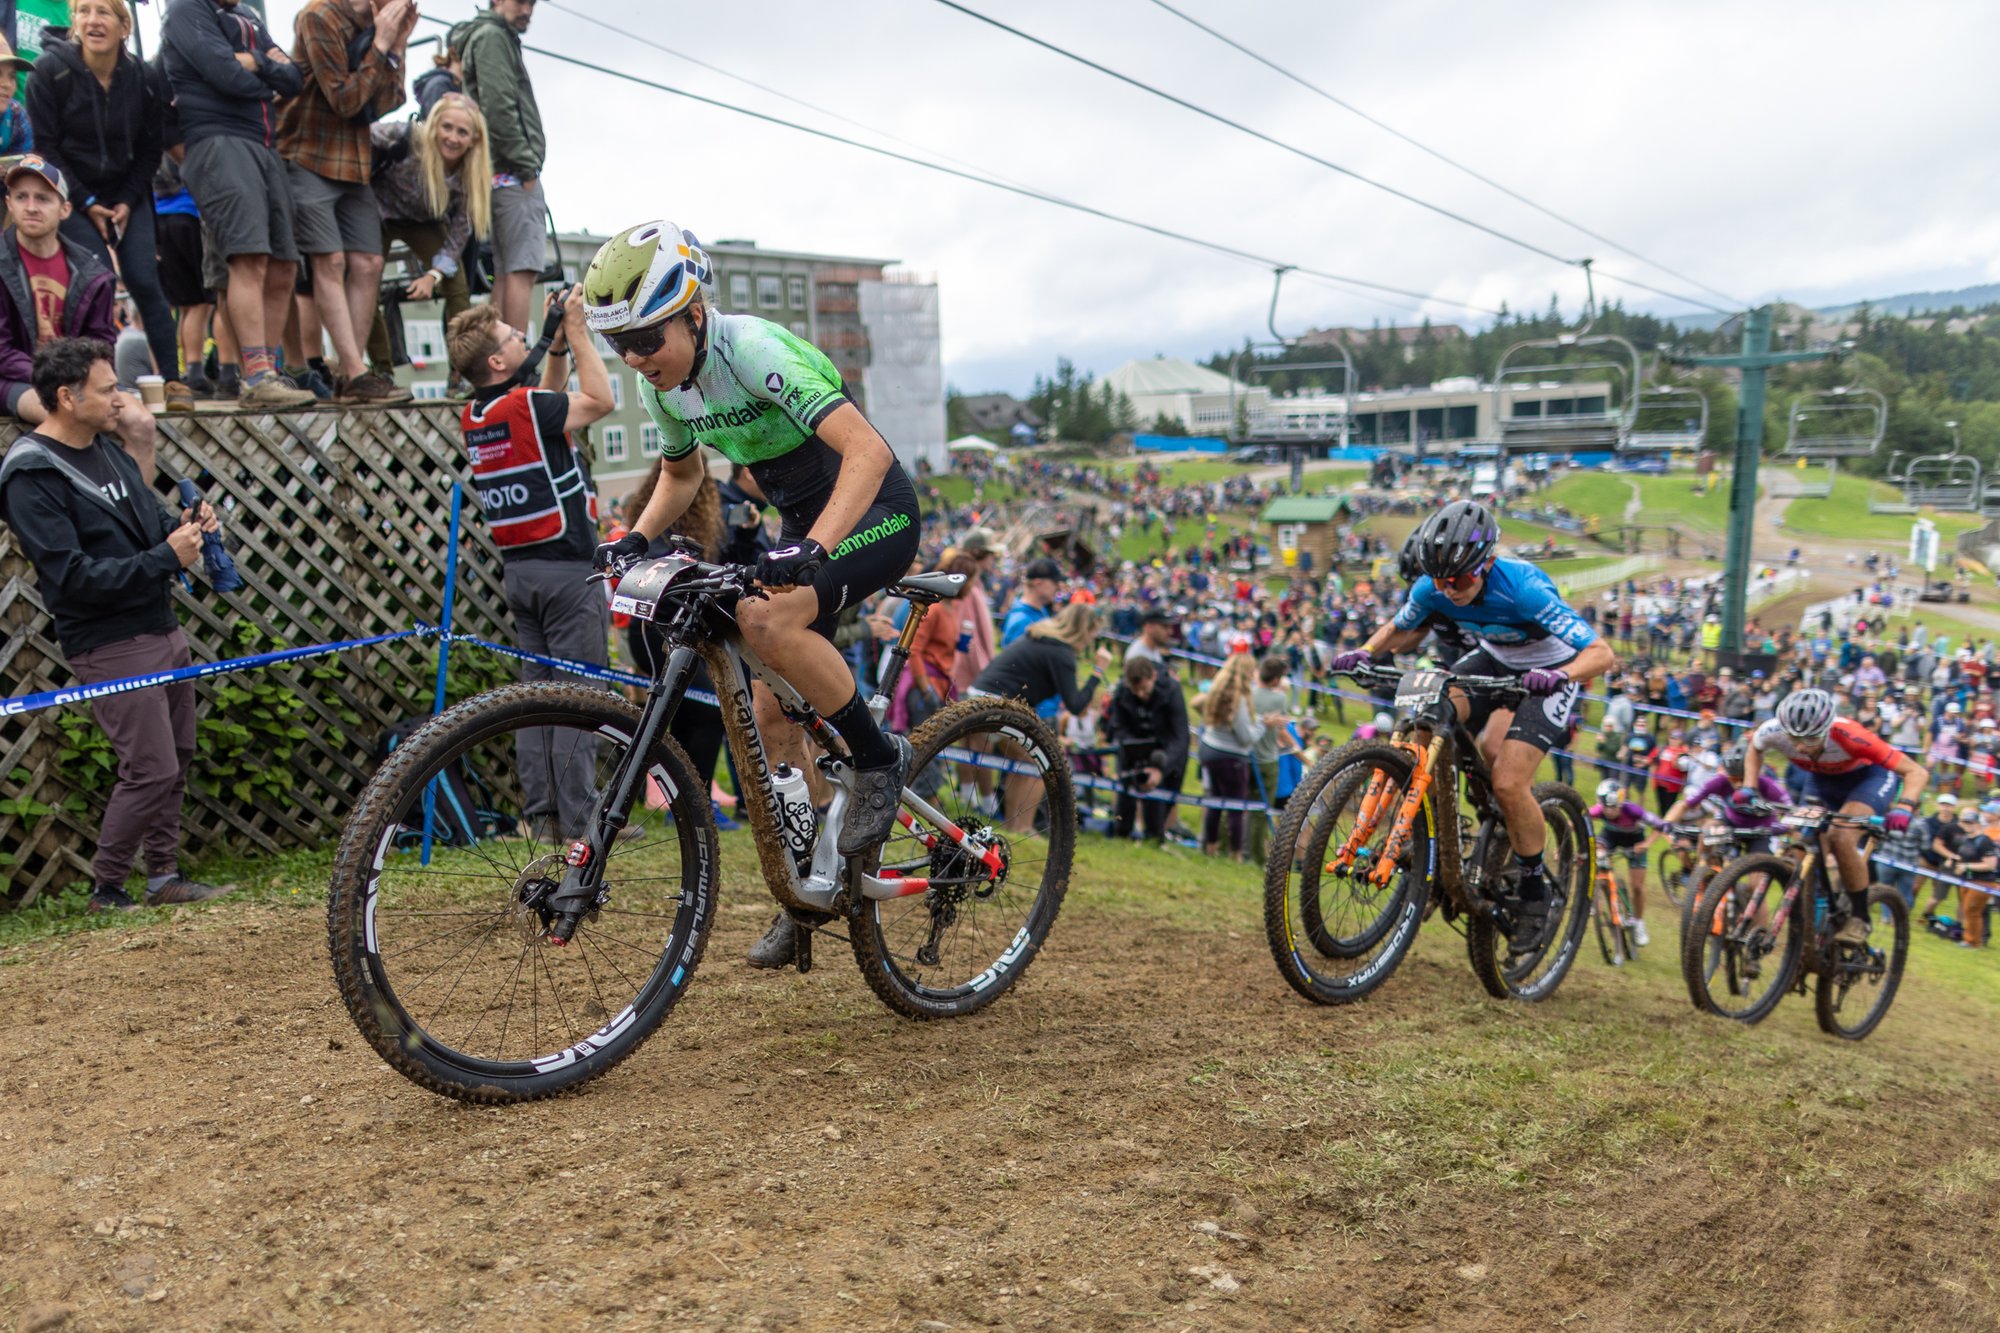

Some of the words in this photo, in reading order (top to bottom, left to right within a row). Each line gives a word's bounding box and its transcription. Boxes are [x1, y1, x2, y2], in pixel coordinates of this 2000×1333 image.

[478, 483, 529, 510] HOTO
[827, 512, 912, 561] cannondale
[636, 562, 669, 588] 5
[677, 826, 710, 965] SCHWALBE
